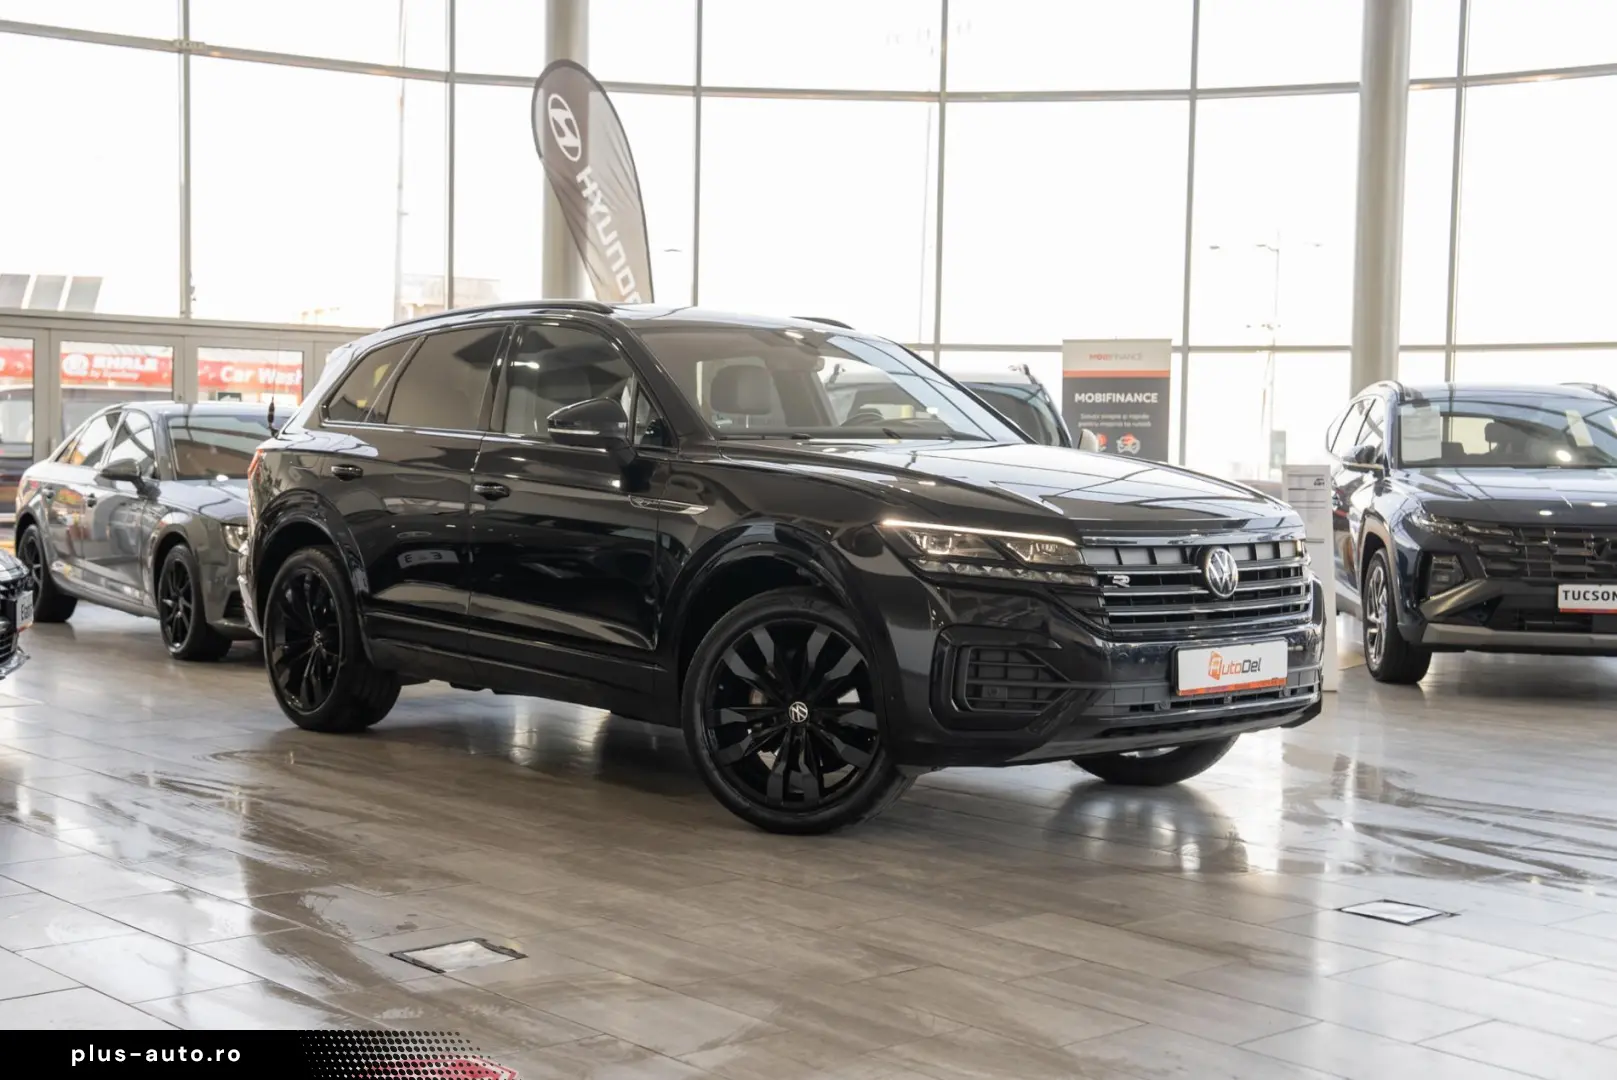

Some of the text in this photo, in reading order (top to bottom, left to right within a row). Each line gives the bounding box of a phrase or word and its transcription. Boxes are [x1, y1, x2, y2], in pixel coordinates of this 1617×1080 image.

[220, 365, 251, 383] Car
[1074, 392, 1159, 403] MOBIFINANCE
[1208, 650, 1262, 681] AutoDel
